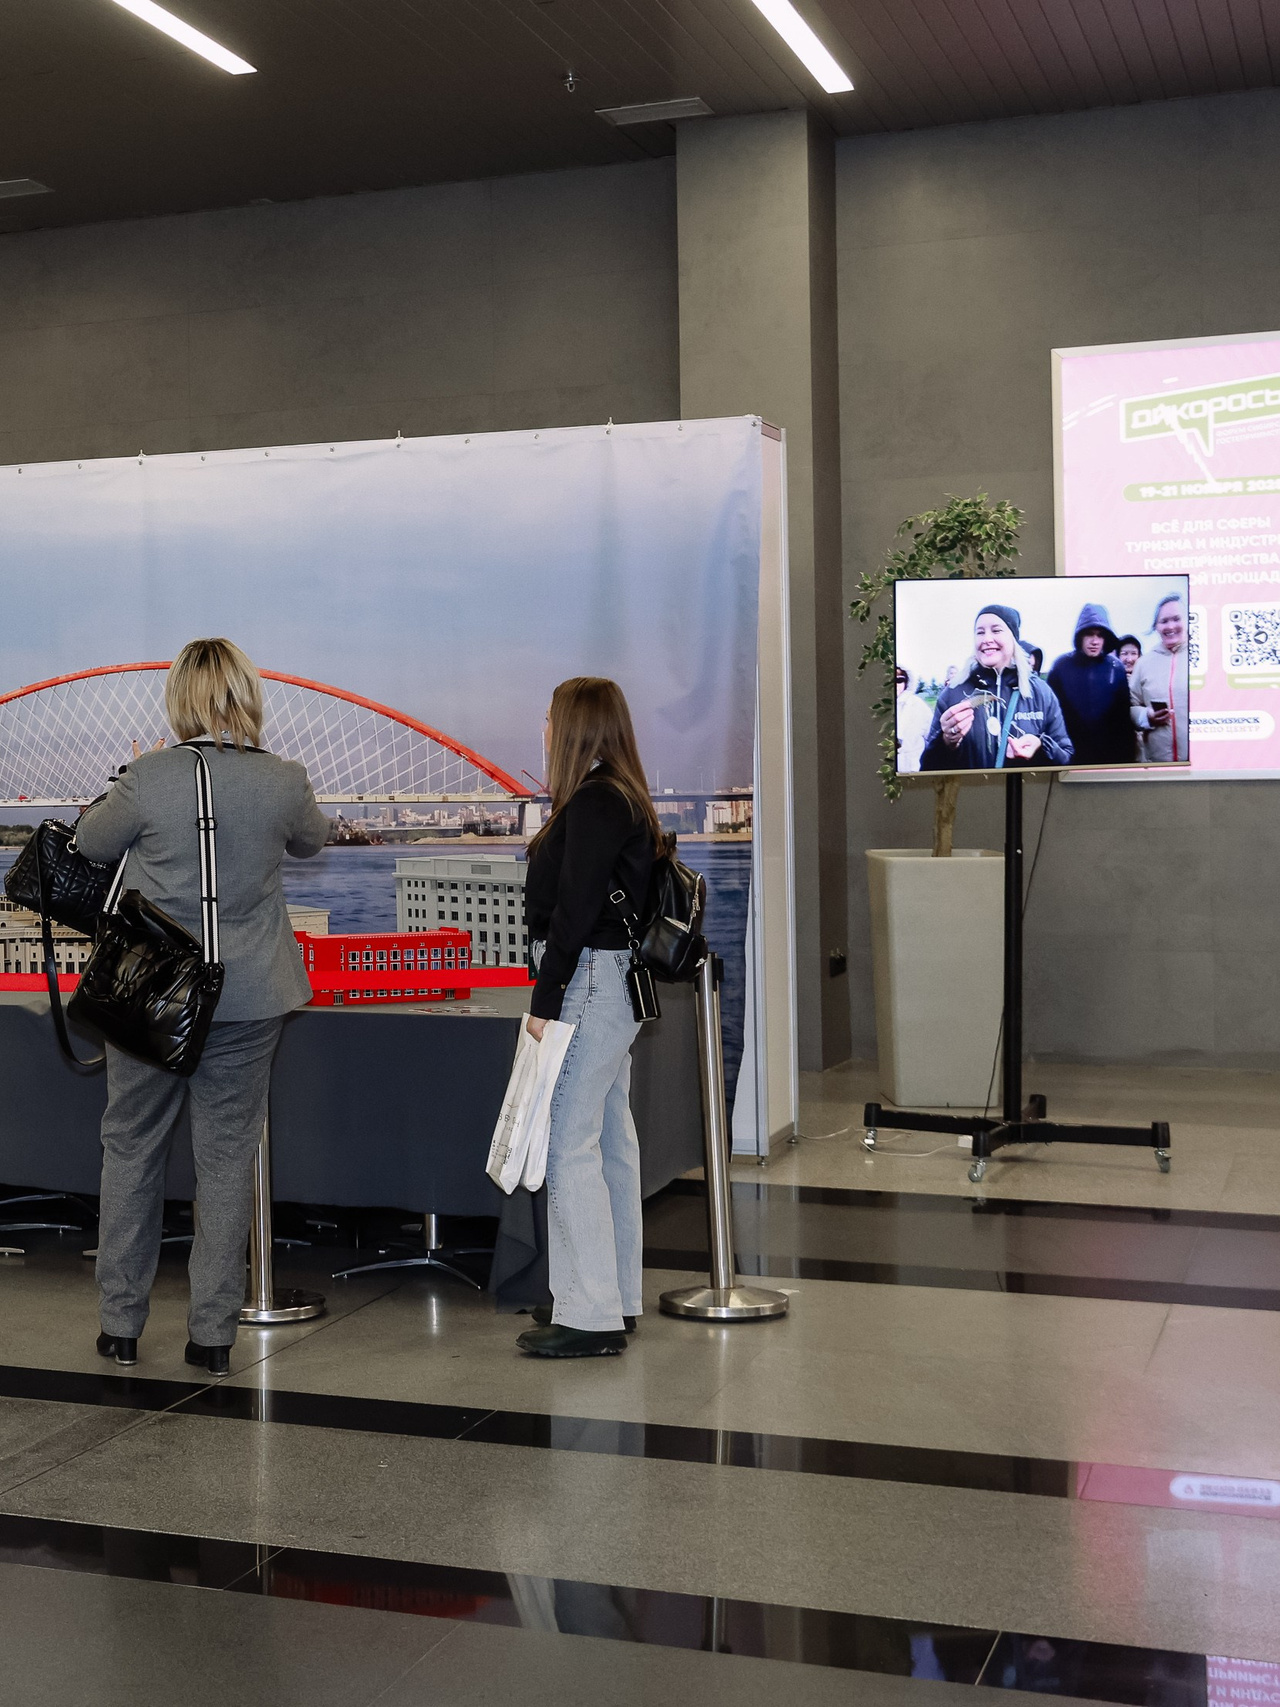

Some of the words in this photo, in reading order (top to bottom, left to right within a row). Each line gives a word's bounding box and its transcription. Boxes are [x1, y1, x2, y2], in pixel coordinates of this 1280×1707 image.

[1151, 519, 1180, 534] ВСЁ
[1182, 519, 1214, 534] ДЛЯ
[1216, 516, 1271, 531] СФЕРЫ
[1125, 538, 1193, 553] ТУРИЗМА
[1195, 538, 1207, 550] И
[1143, 551, 1280, 571] ГОСТЕПРИИМСТВА
[1189, 571, 1209, 587] ОЙ
[1211, 570, 1280, 585] ПЛОЩАД
